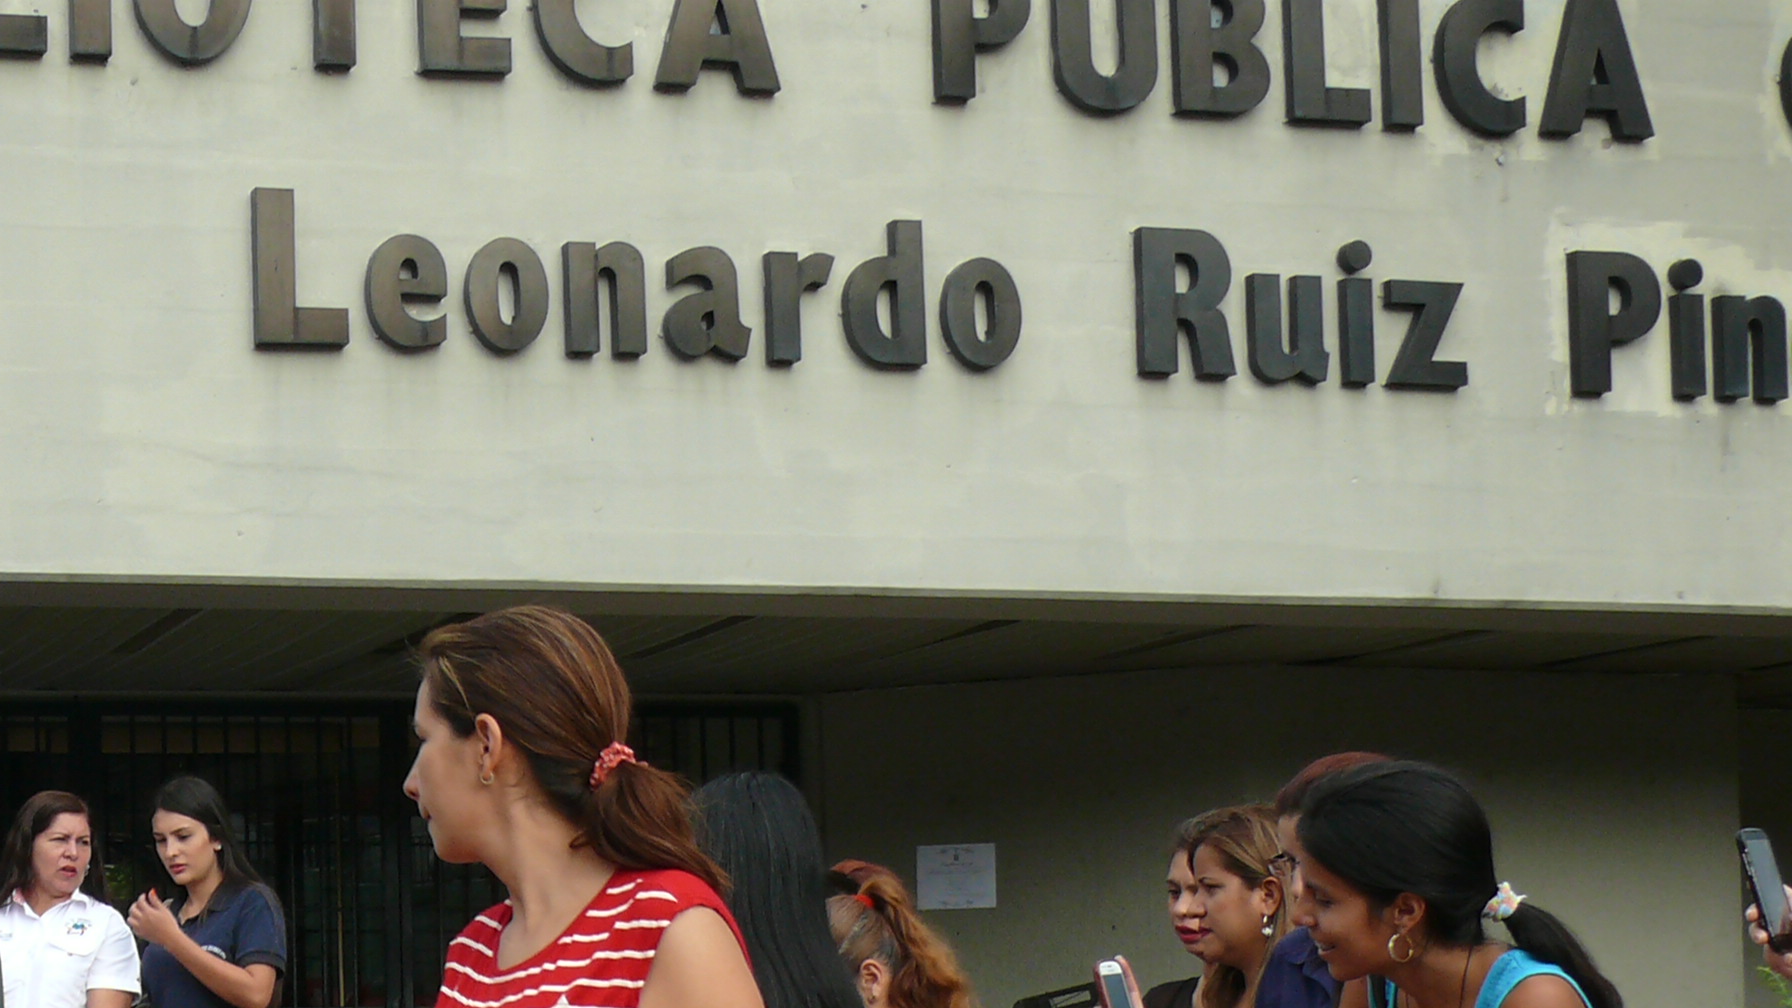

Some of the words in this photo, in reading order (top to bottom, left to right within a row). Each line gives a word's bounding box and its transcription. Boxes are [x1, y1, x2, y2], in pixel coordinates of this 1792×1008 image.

[250, 187, 1022, 372] Leonardo
[1133, 226, 1468, 391] Ruiz
[1565, 249, 1789, 405] Pin
